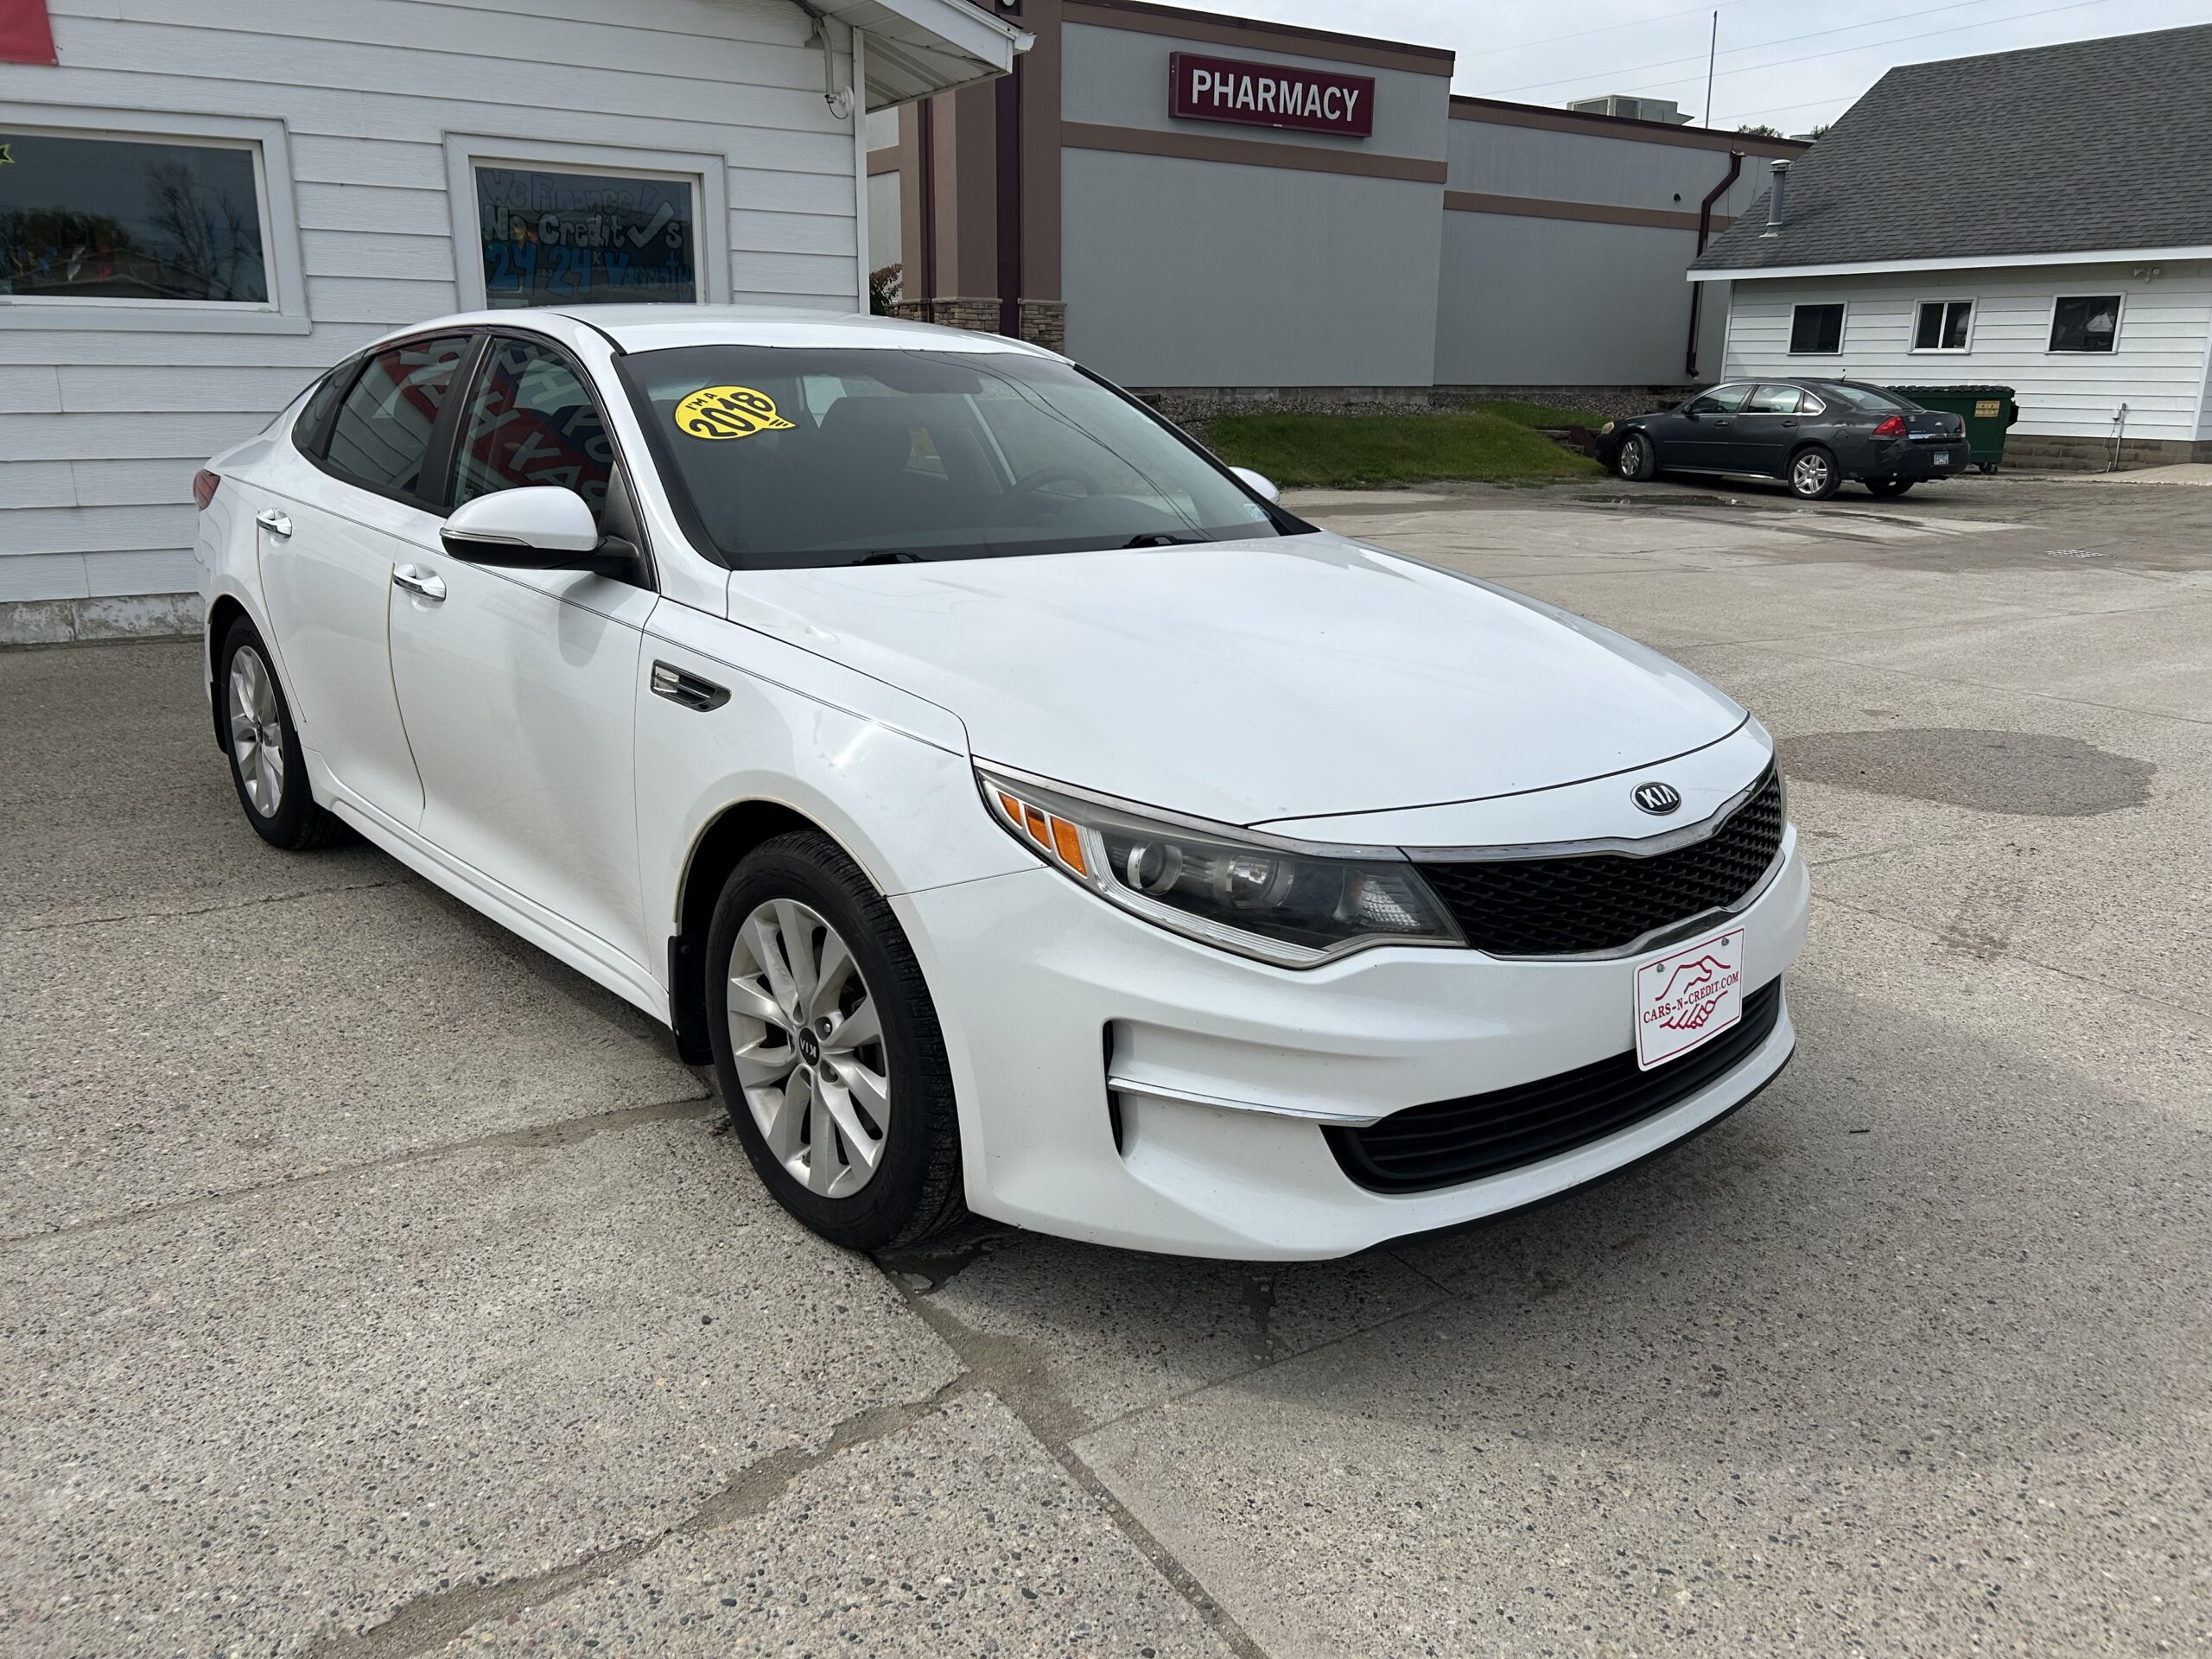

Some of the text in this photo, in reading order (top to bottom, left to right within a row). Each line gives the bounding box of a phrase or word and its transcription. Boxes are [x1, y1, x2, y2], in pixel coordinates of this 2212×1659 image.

[1192, 69, 1359, 122] PHARMACY
[480, 169, 527, 208] We
[483, 203, 527, 241] No
[537, 213, 626, 249] Credit
[485, 241, 537, 296] 24
[545, 245, 593, 300] 24
[685, 391, 718, 410] I'M A
[689, 391, 773, 437] 2018
[1637, 785, 1678, 809] KIA
[1643, 971, 1739, 1024] CARS-N-CREDIT.COM
[800, 1037, 817, 1058] KIA
